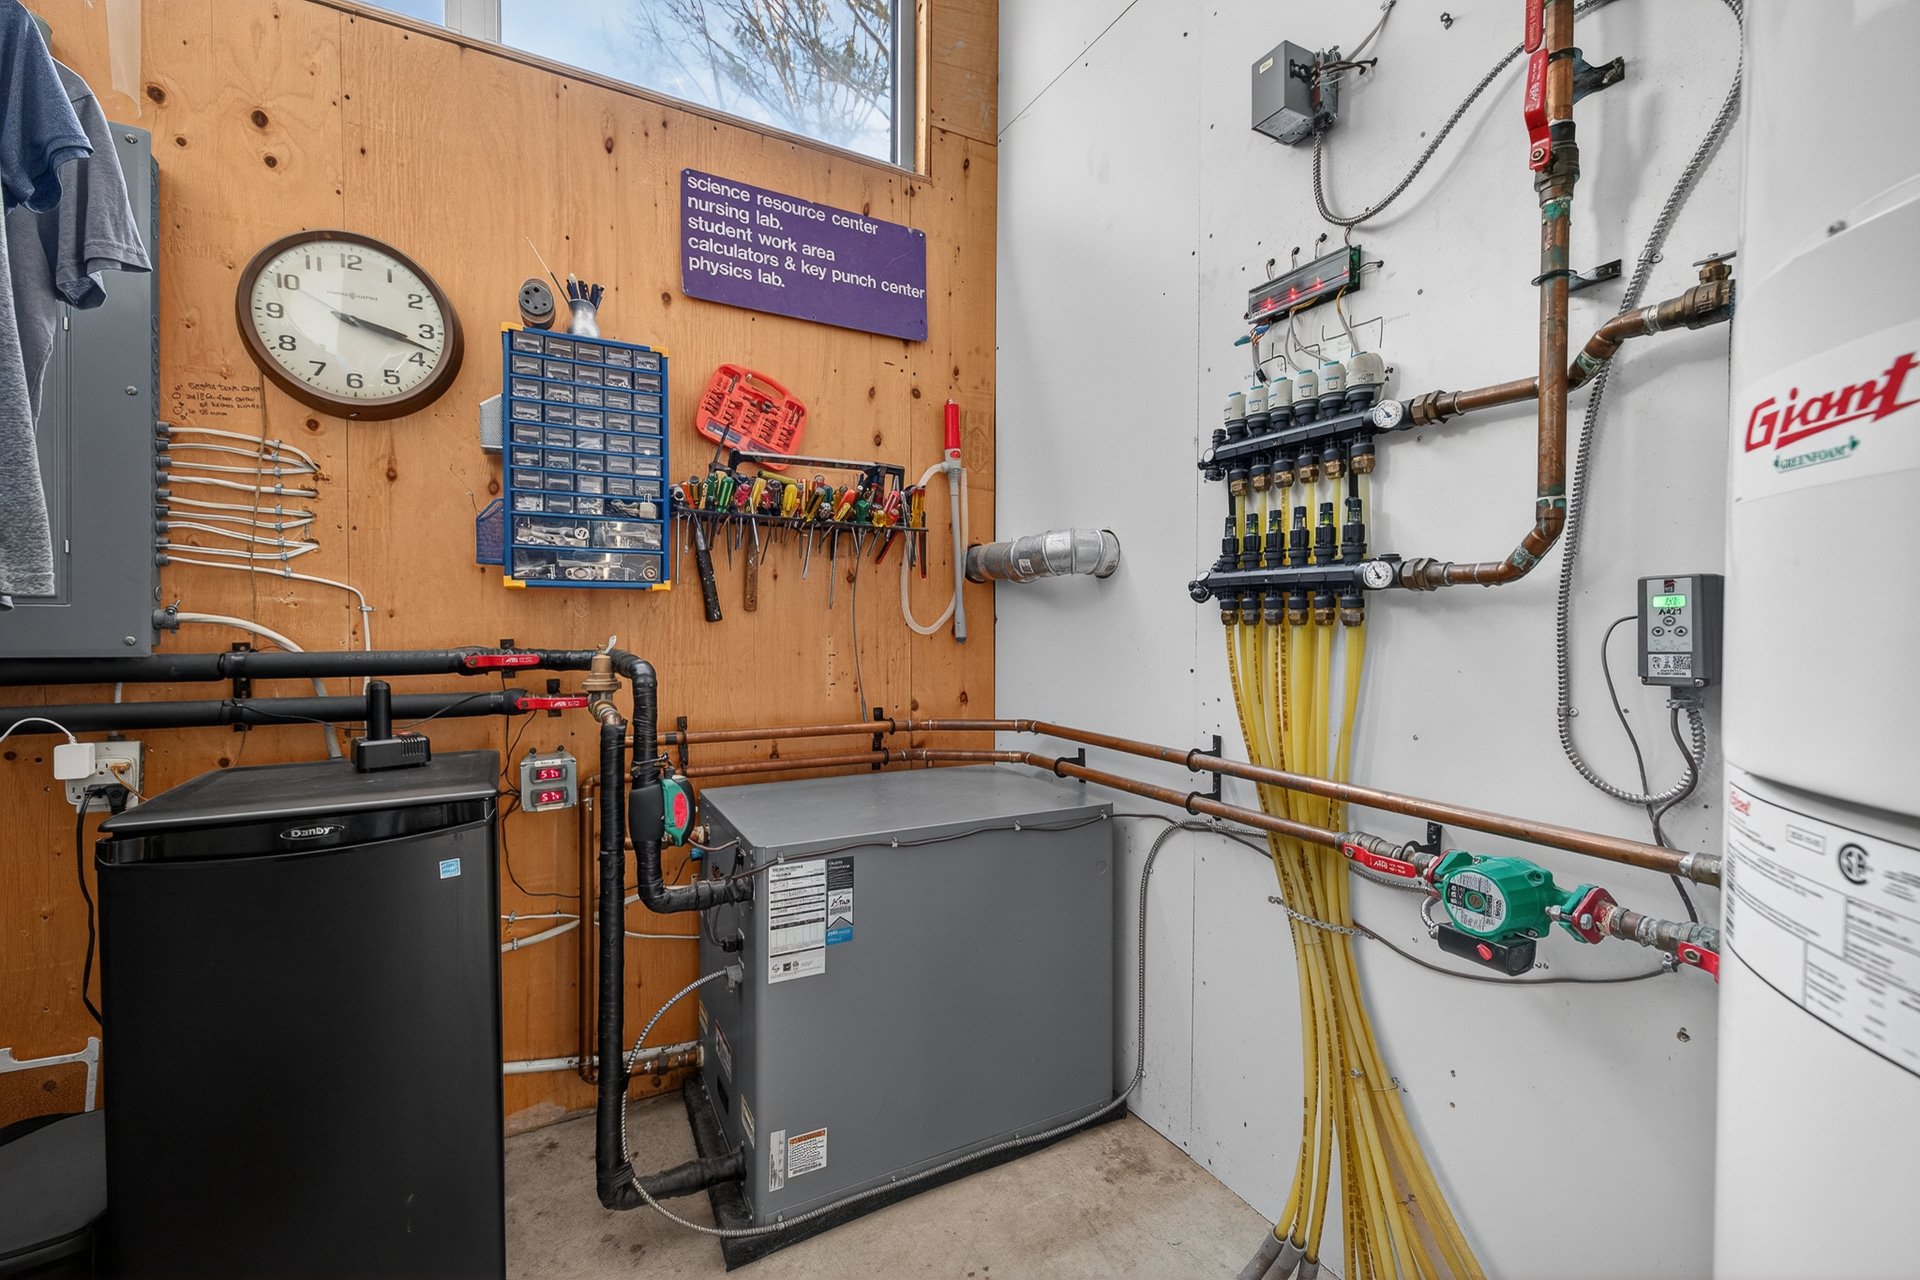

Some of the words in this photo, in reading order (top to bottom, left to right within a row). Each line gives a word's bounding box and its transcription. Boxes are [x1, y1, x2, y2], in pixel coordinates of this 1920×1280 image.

[688, 176, 750, 201] science
[757, 194, 825, 221] resource
[832, 214, 878, 235] center
[688, 196, 749, 224] nursing
[756, 210, 783, 230] lab.
[688, 216, 753, 242] student
[758, 234, 797, 252] work
[802, 244, 835, 261] area
[305, 255, 322, 271] 11
[340, 253, 363, 271] 12
[688, 237, 779, 267] calculators
[784, 256, 796, 271] &
[801, 260, 827, 280] key
[832, 269, 876, 289] punch
[881, 280, 925, 299] center
[387, 269, 393, 283] 1
[689, 256, 752, 280] physics
[758, 268, 785, 288] lab.
[277, 272, 300, 291] 10
[408, 293, 423, 310] 2
[266, 302, 284, 318] 9
[418, 324, 435, 340] 3
[279, 335, 297, 351] 8
[408, 352, 426, 367] 4
[309, 360, 326, 376] 7
[347, 373, 364, 389] 6
[384, 369, 400, 385] 5
[1745, 351, 1920, 453] Giant
